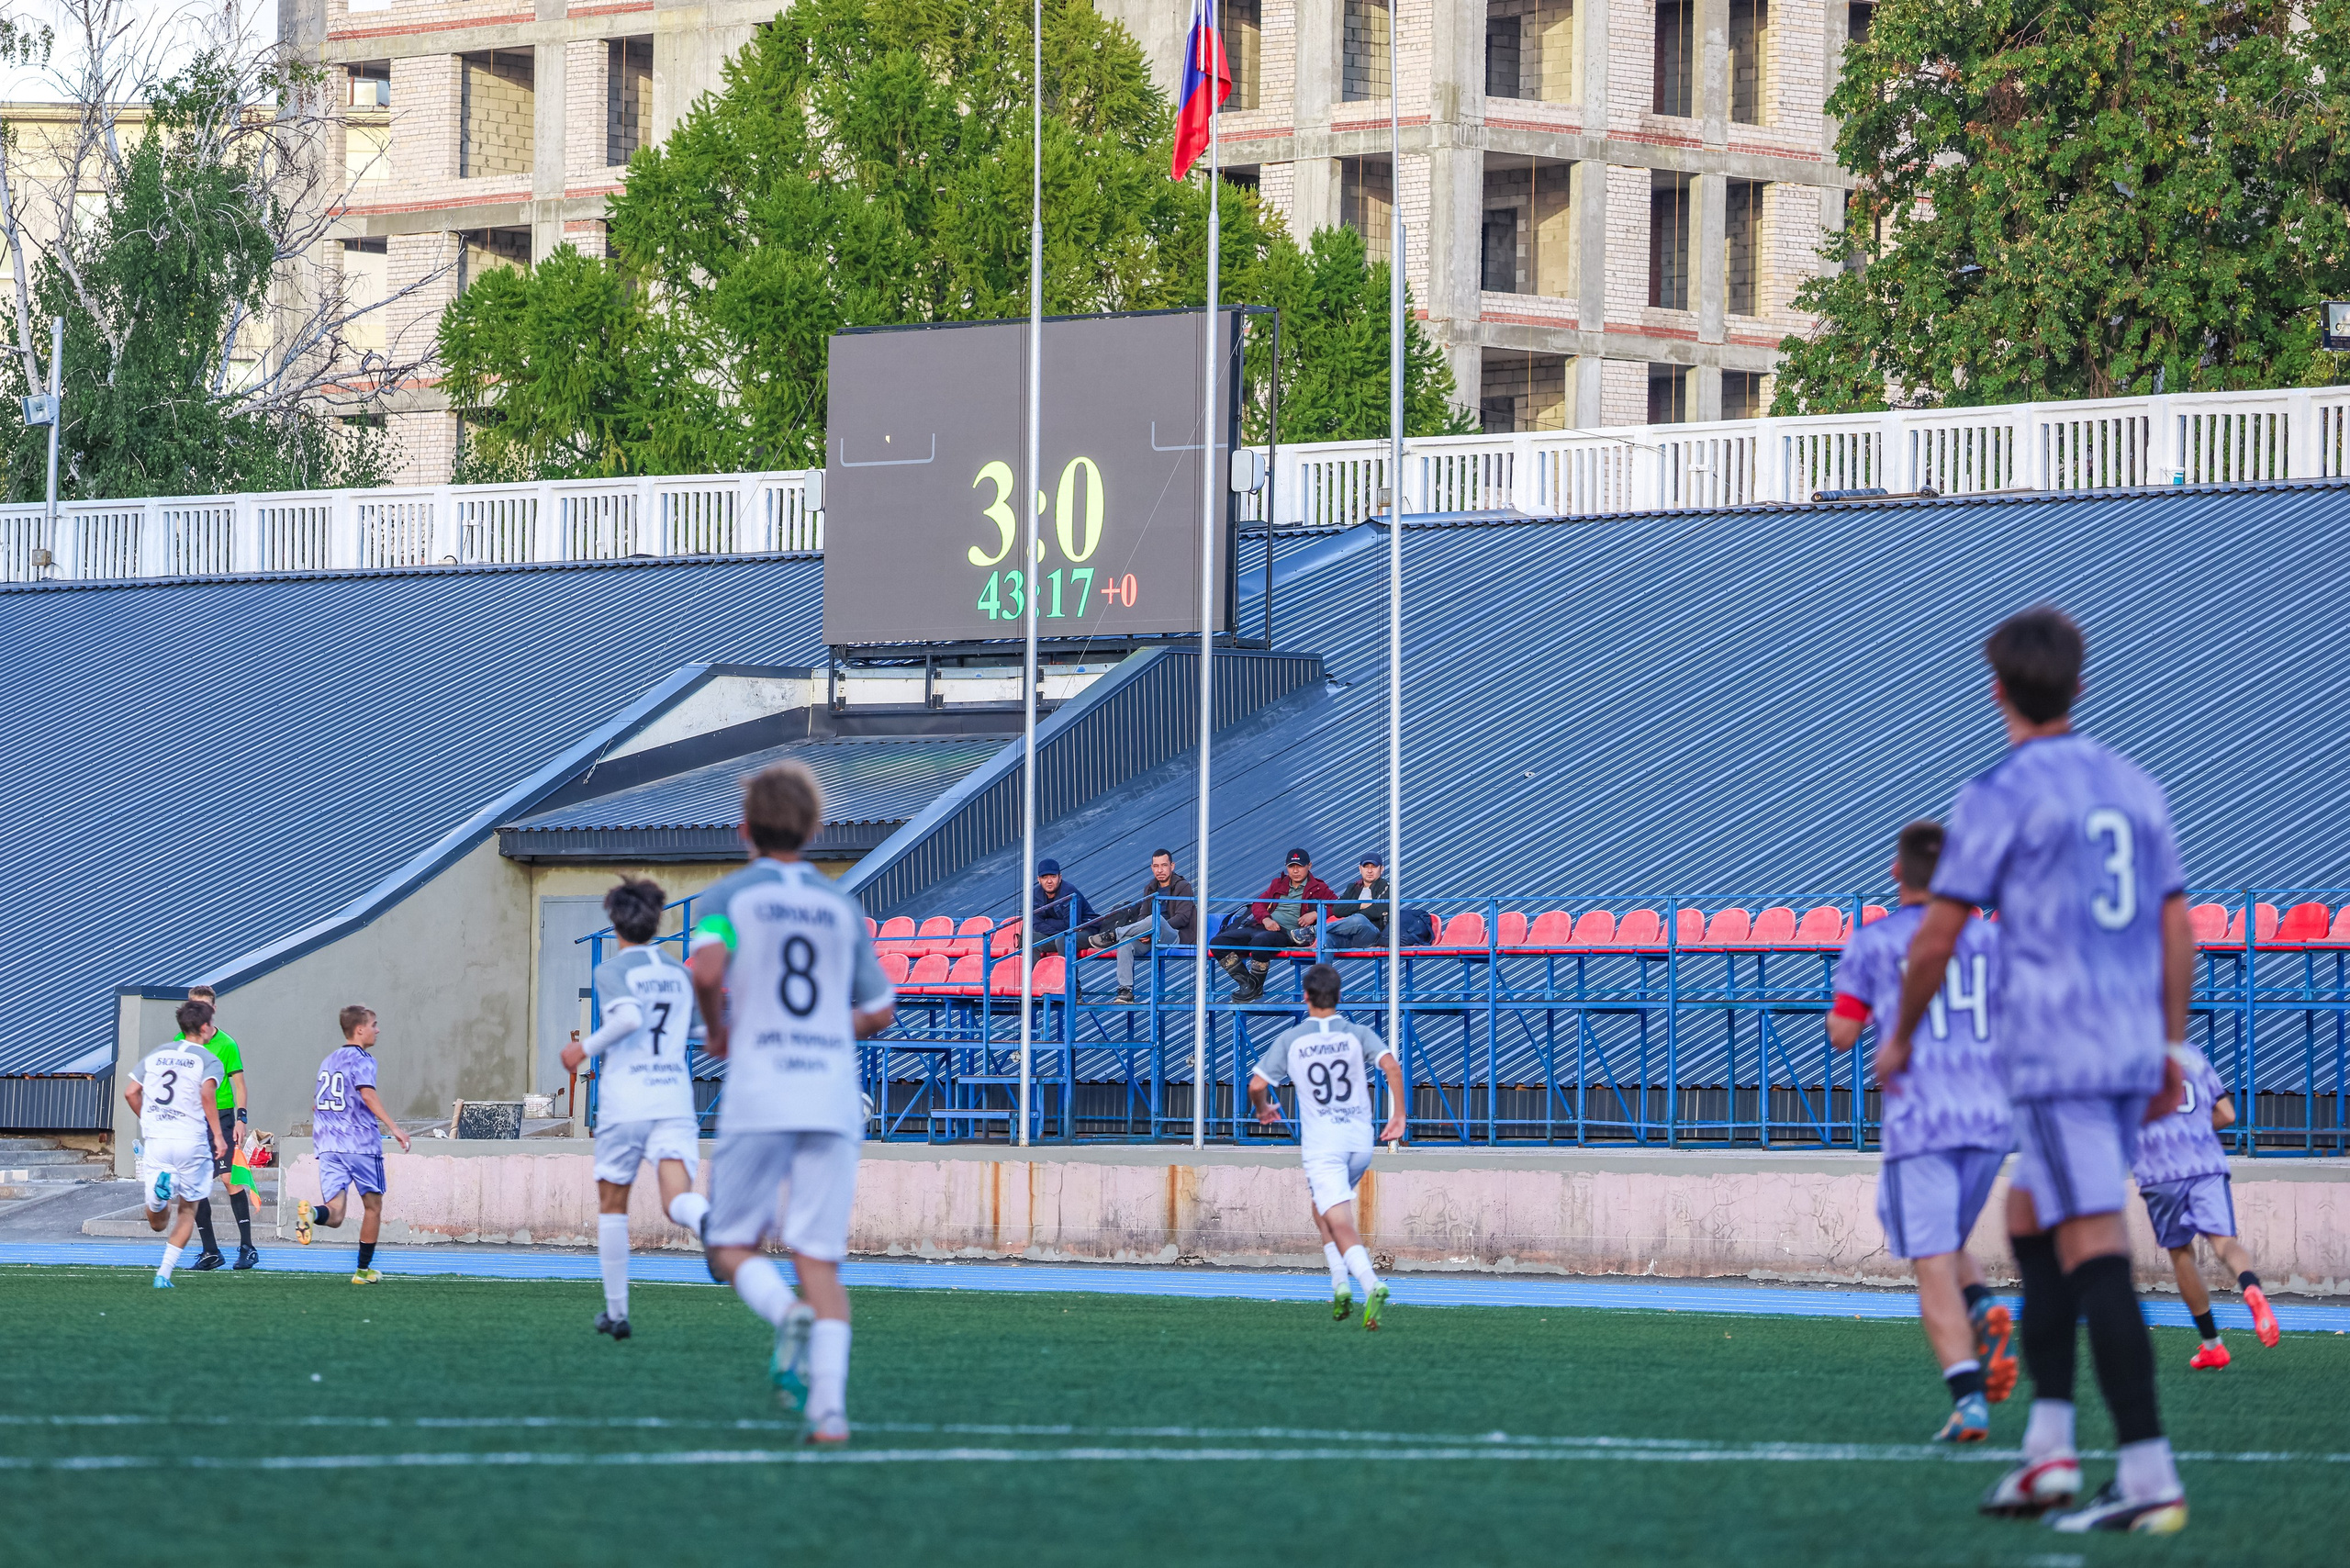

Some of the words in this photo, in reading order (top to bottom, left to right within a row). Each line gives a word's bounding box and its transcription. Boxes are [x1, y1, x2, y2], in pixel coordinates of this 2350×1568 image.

[968, 456, 1104, 566] 3:0
[1101, 573, 1137, 608] +0
[2086, 807, 2136, 930] 3
[779, 935, 818, 1018] 8
[649, 1002, 671, 1056] 7
[154, 1070, 178, 1106] 3
[316, 1070, 347, 1112] 29
[1307, 1058, 1352, 1106] 93
